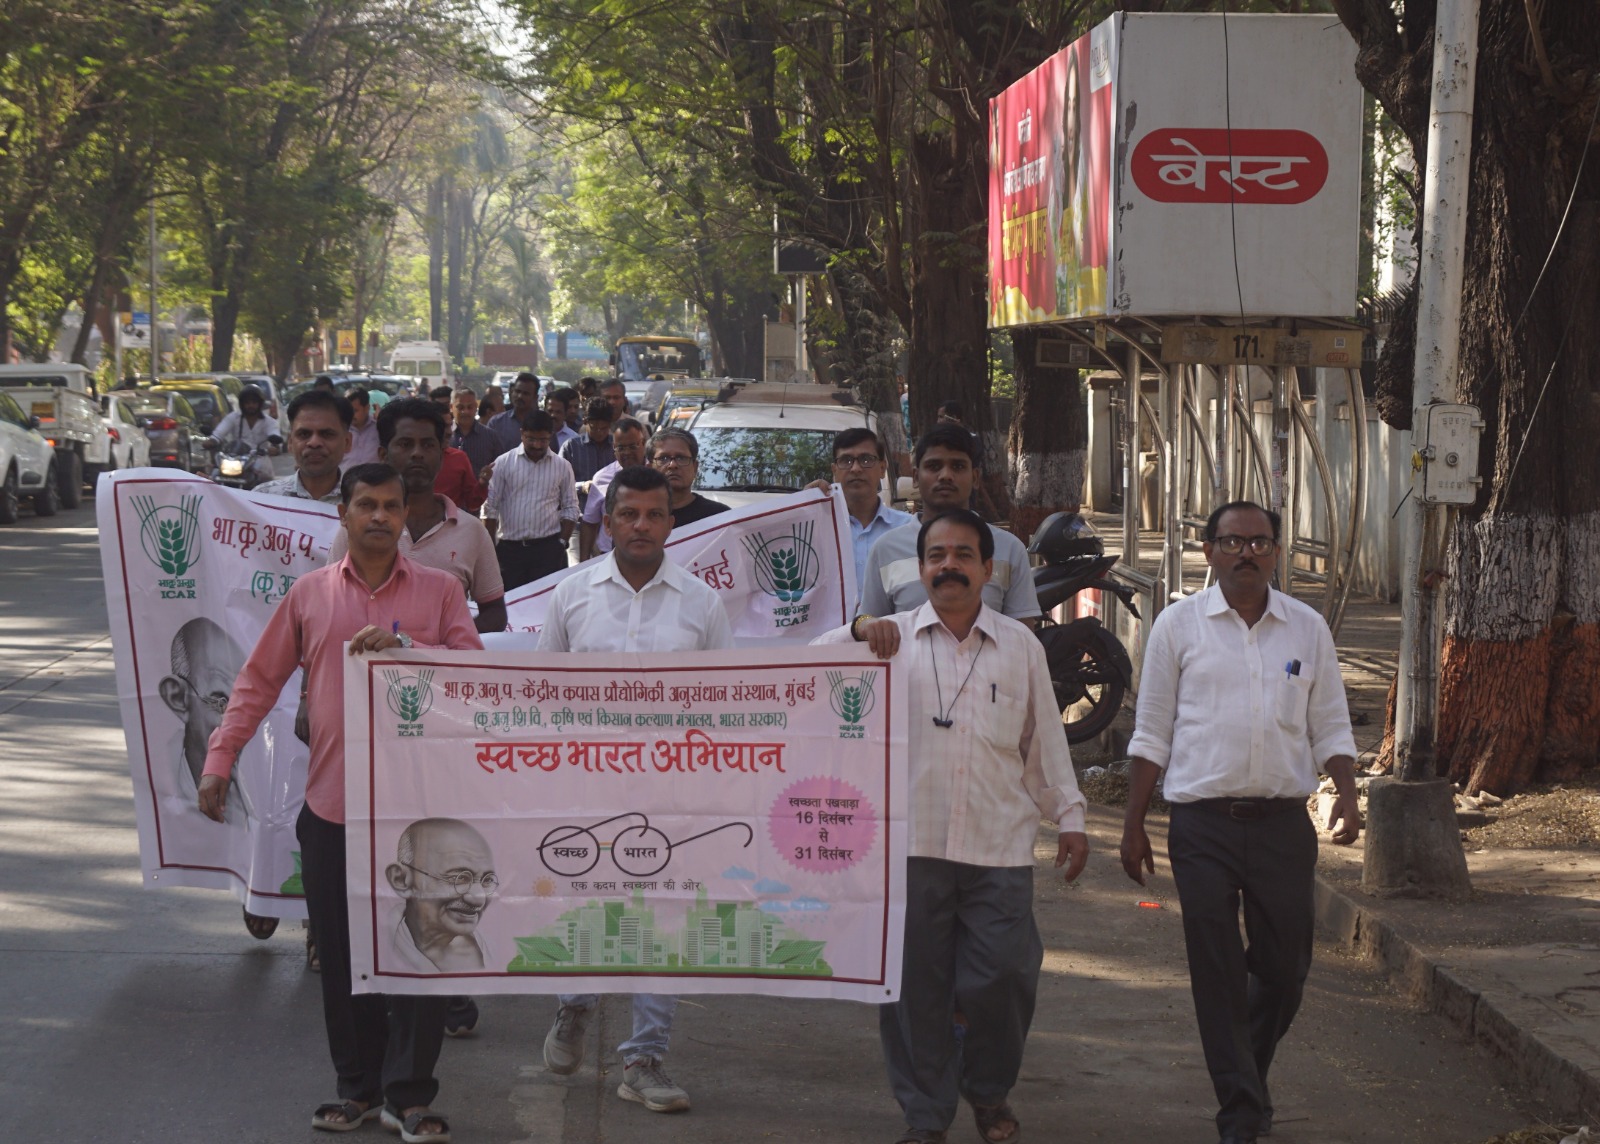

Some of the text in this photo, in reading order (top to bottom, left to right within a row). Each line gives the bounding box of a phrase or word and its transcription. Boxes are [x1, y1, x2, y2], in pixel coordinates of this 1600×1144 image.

[1149, 137, 1310, 194] बेस्ट
[161, 590, 197, 599] ICAR
[775, 613, 809, 628] ICAR
[563, 685, 600, 702] कपास
[604, 680, 664, 703] प्रौद्योगिकी
[668, 681, 727, 709] अनुसंधान
[731, 681, 781, 703] संस्थान,
[785, 676, 816, 706] मुंबई
[551, 707, 574, 732] कृषि
[577, 708, 593, 726] एवं
[597, 707, 632, 726] किसान
[635, 712, 673, 727] कल्याण
[676, 710, 716, 729] मंत्रालय,
[719, 712, 745, 727] भारत
[748, 711, 788, 730] सरकार)
[475, 729, 786, 774] स्वच्छ भारत अभियान
[788, 797, 860, 811] स्वच्छता पखवाड़ा
[796, 810, 854, 826] 16 दिसंबर
[819, 827, 829, 843] से
[553, 845, 657, 860] स्वच्छ भारत
[794, 845, 854, 862] 31 दिसंबर
[571, 878, 702, 891] एक कदम स्वच्छता की ओर
